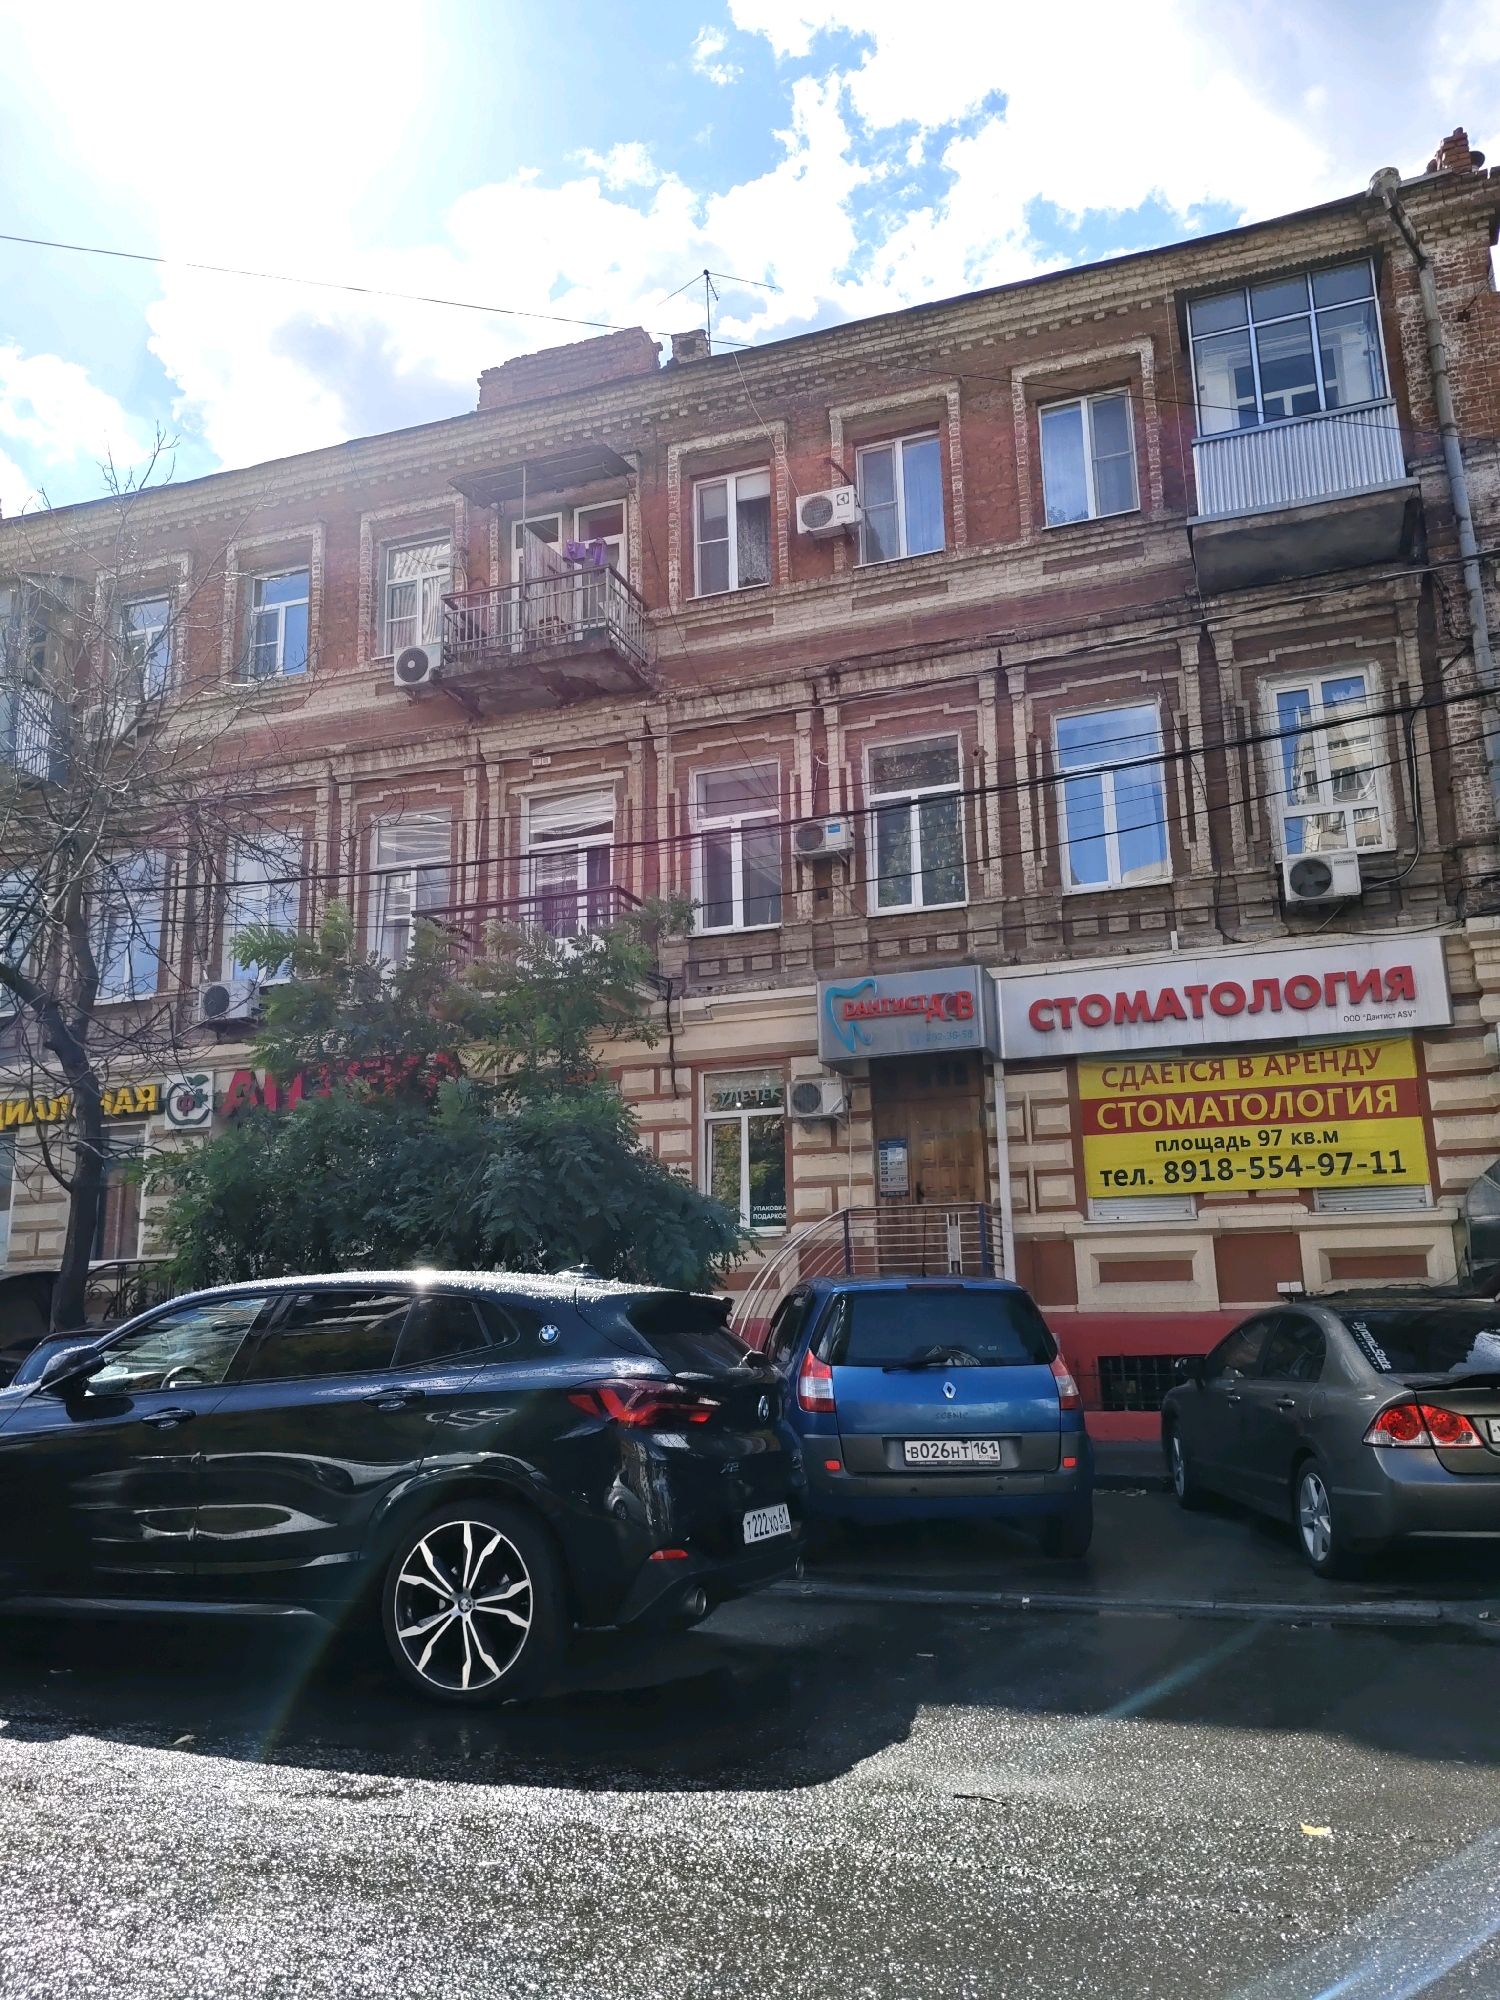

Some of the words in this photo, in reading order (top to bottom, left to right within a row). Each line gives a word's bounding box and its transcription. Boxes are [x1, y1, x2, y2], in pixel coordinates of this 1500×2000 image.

[1029, 966, 1416, 1031] СТОМАТОЛОГИЯ
[1102, 1059, 1226, 1092] СДАЕТСЯ
[1237, 1057, 1254, 1078] В
[1263, 1047, 1382, 1077] АРЕНДУ
[1097, 1084, 1398, 1129] СТОМАТОЛОГИЯ
[1155, 1135, 1251, 1153] площадь
[1257, 1128, 1283, 1147] 97
[1291, 1130, 1339, 1146] кв.м
[1099, 1168, 1154, 1187] тел.
[1164, 1149, 1407, 1185] 8918-554-97-11
[935, 1411, 969, 1419] SCENIC
[973, 1442, 997, 1455] 161
